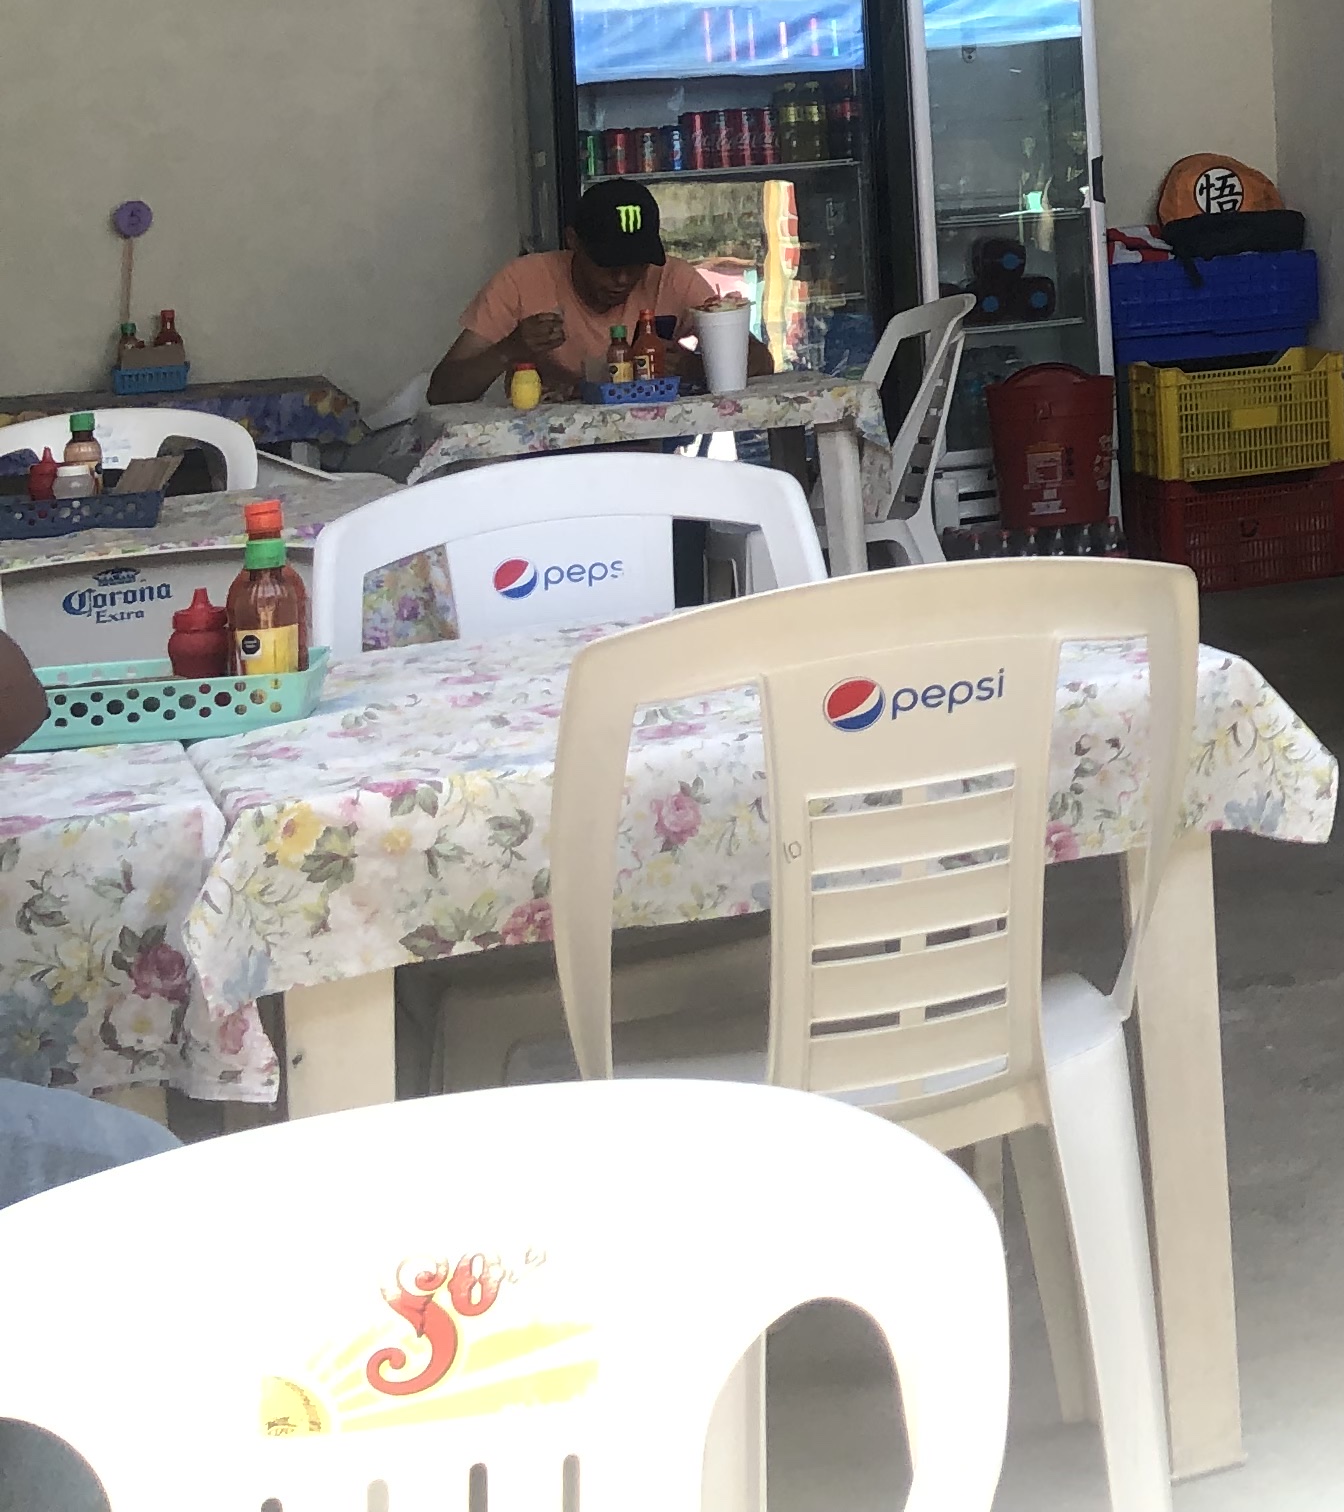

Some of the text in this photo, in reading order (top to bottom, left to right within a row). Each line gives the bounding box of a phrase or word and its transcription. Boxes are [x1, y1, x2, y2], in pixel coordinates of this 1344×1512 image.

[1199, 172, 1242, 215] 悟
[63, 583, 171, 617] Corona
[96, 609, 145, 624] Extra
[892, 668, 1005, 721] pepsi
